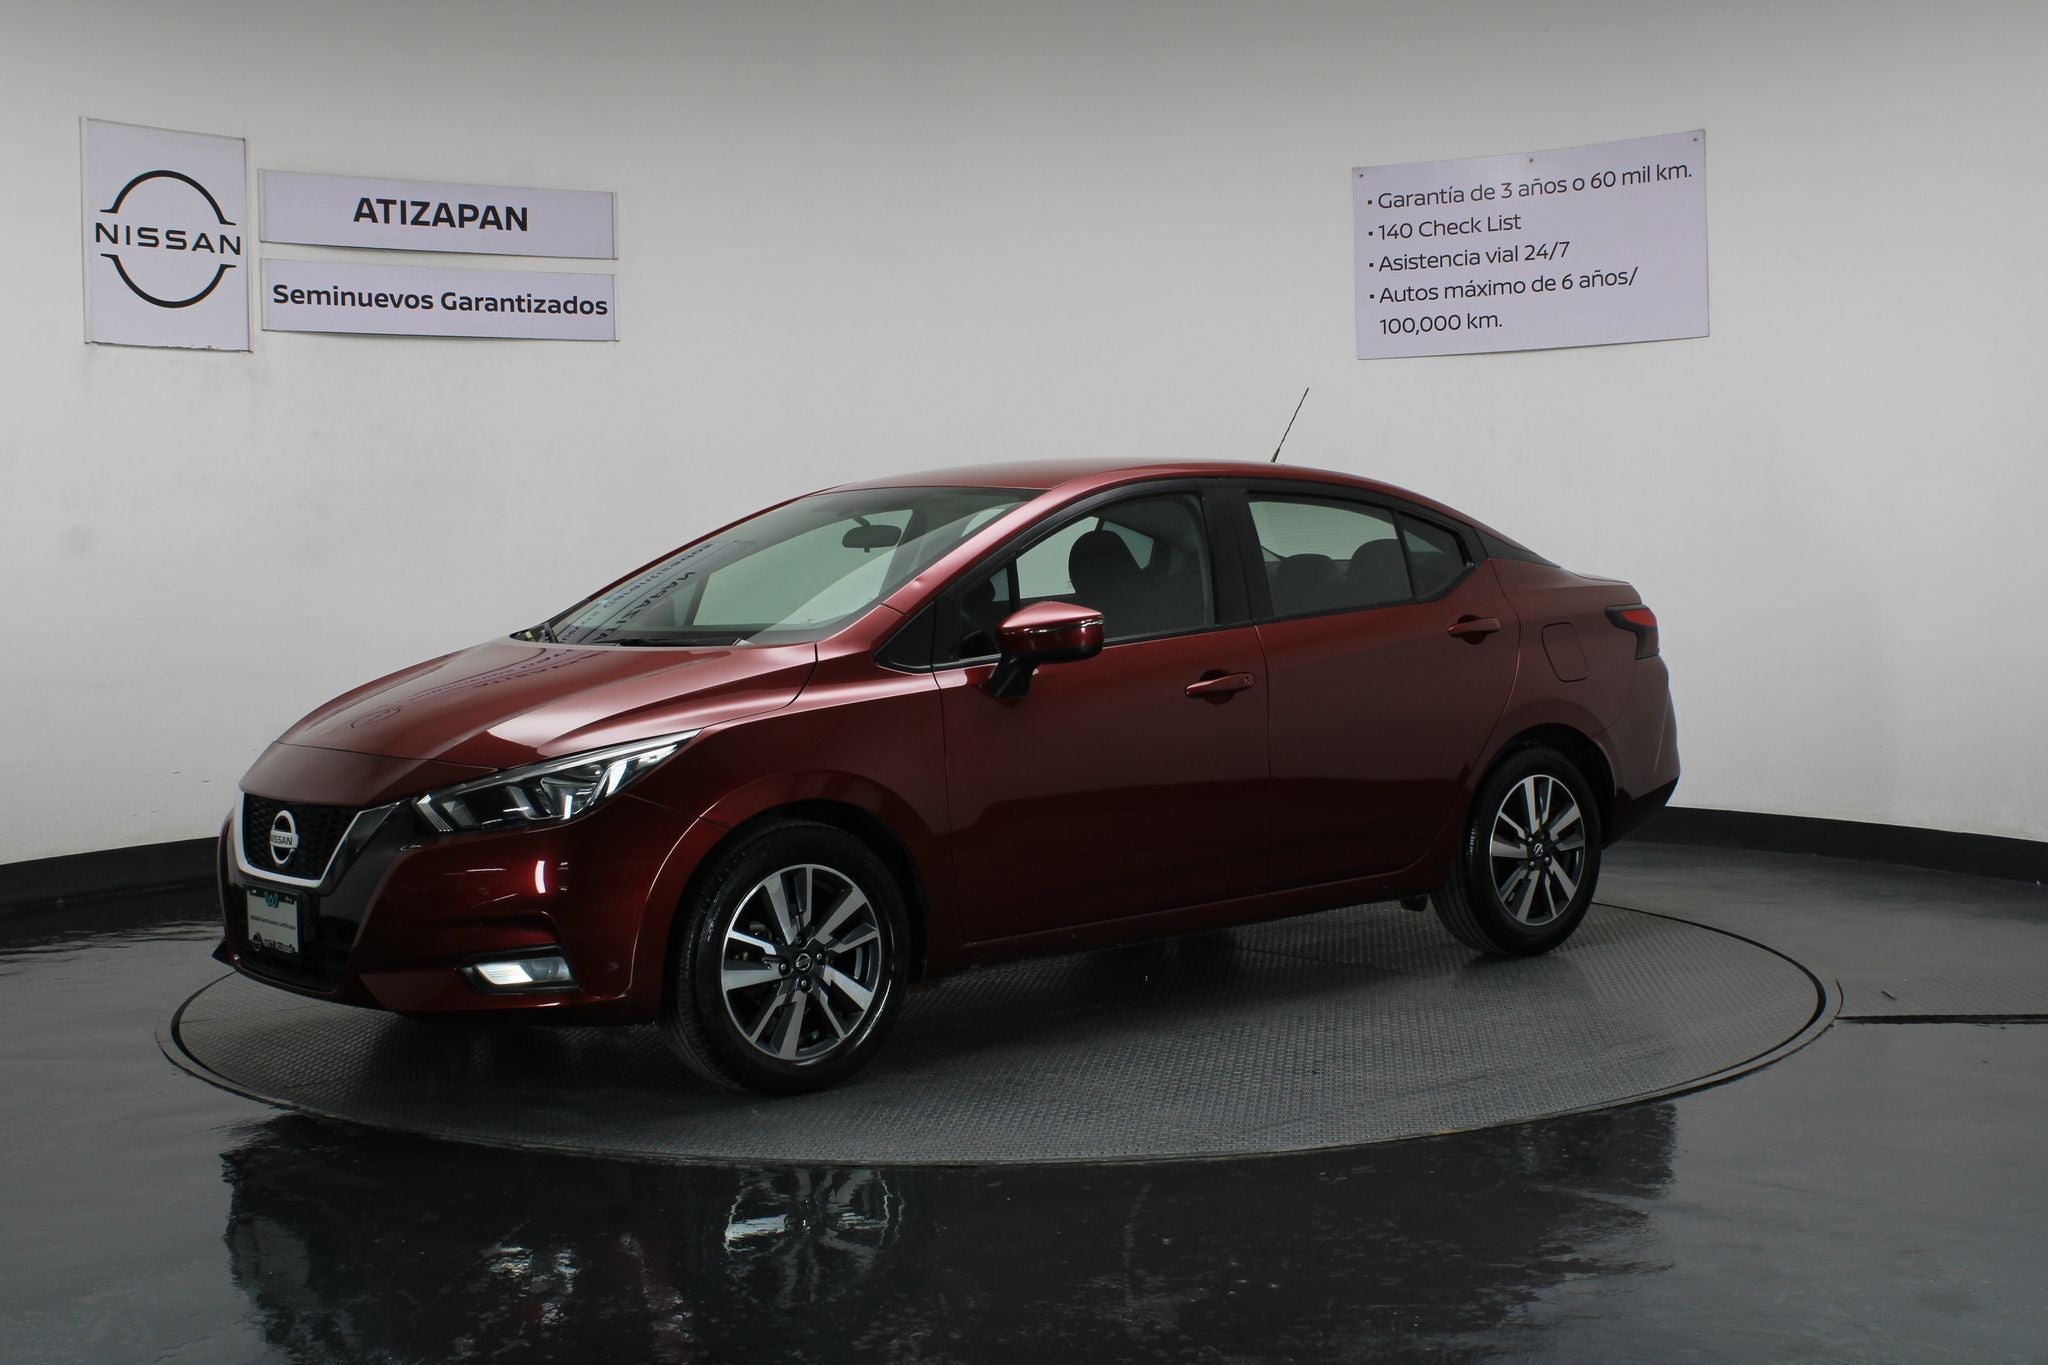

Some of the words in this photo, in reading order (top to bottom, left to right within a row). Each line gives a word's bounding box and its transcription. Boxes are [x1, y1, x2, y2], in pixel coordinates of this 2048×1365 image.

[1377, 185, 1465, 209] Garantía
[1470, 184, 1496, 202] de
[1501, 182, 1513, 199] 3
[1518, 177, 1568, 198] años
[1572, 177, 1586, 192] o
[1590, 170, 1617, 190] 60
[1621, 164, 1651, 186] mil
[1656, 163, 1693, 182] km.
[353, 197, 528, 232] ATIZAPAN
[1378, 222, 1413, 241] 140
[1418, 216, 1483, 238] Check
[1487, 213, 1522, 232] List
[95, 222, 241, 256] NISSAN
[1378, 249, 1481, 273] Asistencia
[1485, 244, 1519, 264] vial
[1524, 240, 1571, 262] 24/7
[273, 284, 434, 310] Seminuevos
[440, 291, 608, 316] Garantizados
[1379, 285, 1439, 304] Autos
[1444, 279, 1526, 300] máximo
[1531, 275, 1557, 293] de
[1561, 273, 1574, 290] 6
[1578, 266, 1639, 289] años/
[1379, 314, 1462, 336] 100,000
[1467, 312, 1503, 330] km.
